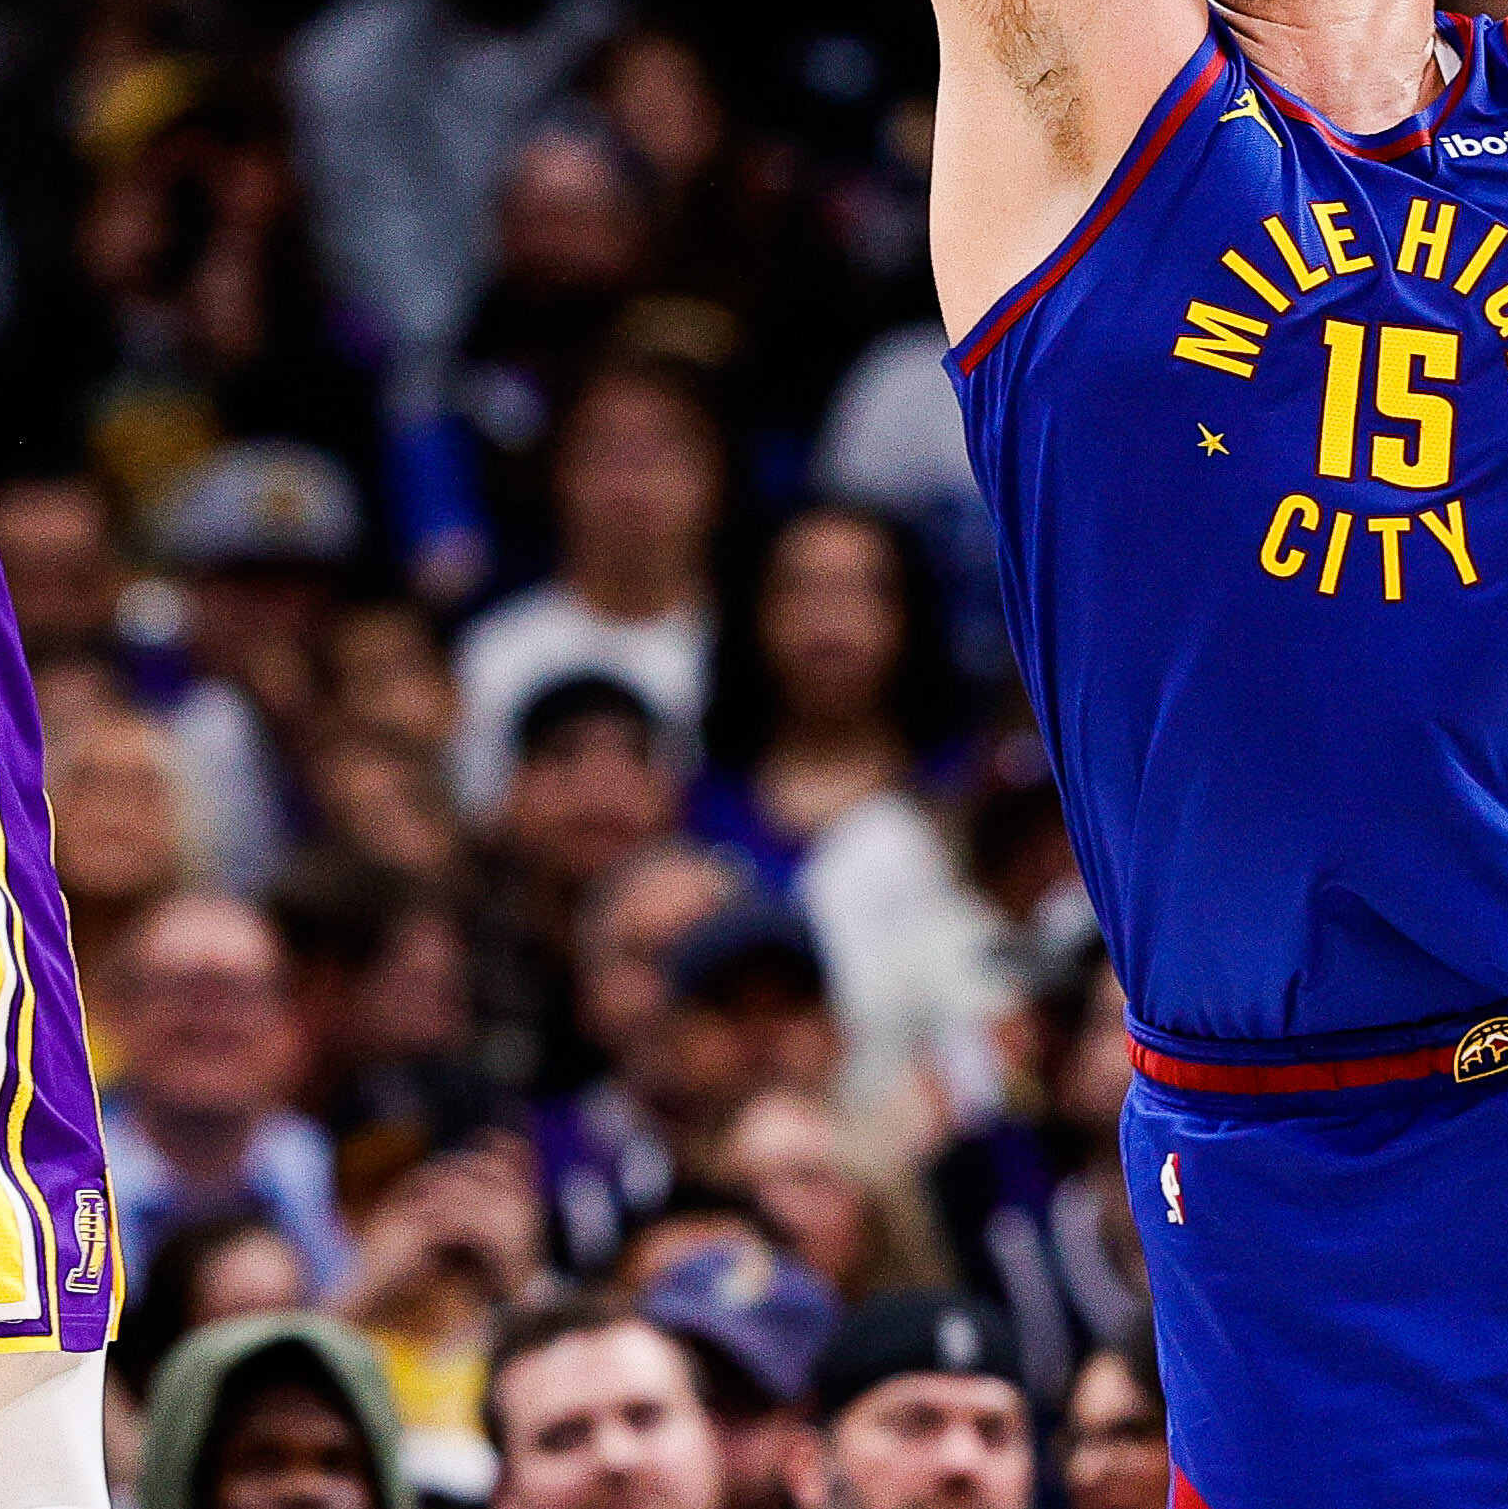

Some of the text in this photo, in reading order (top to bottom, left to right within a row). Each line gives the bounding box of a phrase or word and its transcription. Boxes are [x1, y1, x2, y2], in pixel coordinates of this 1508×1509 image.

[1172, 200, 1376, 381] MILE
[1315, 315, 1464, 493] 15
[1258, 491, 1481, 604] CITY
